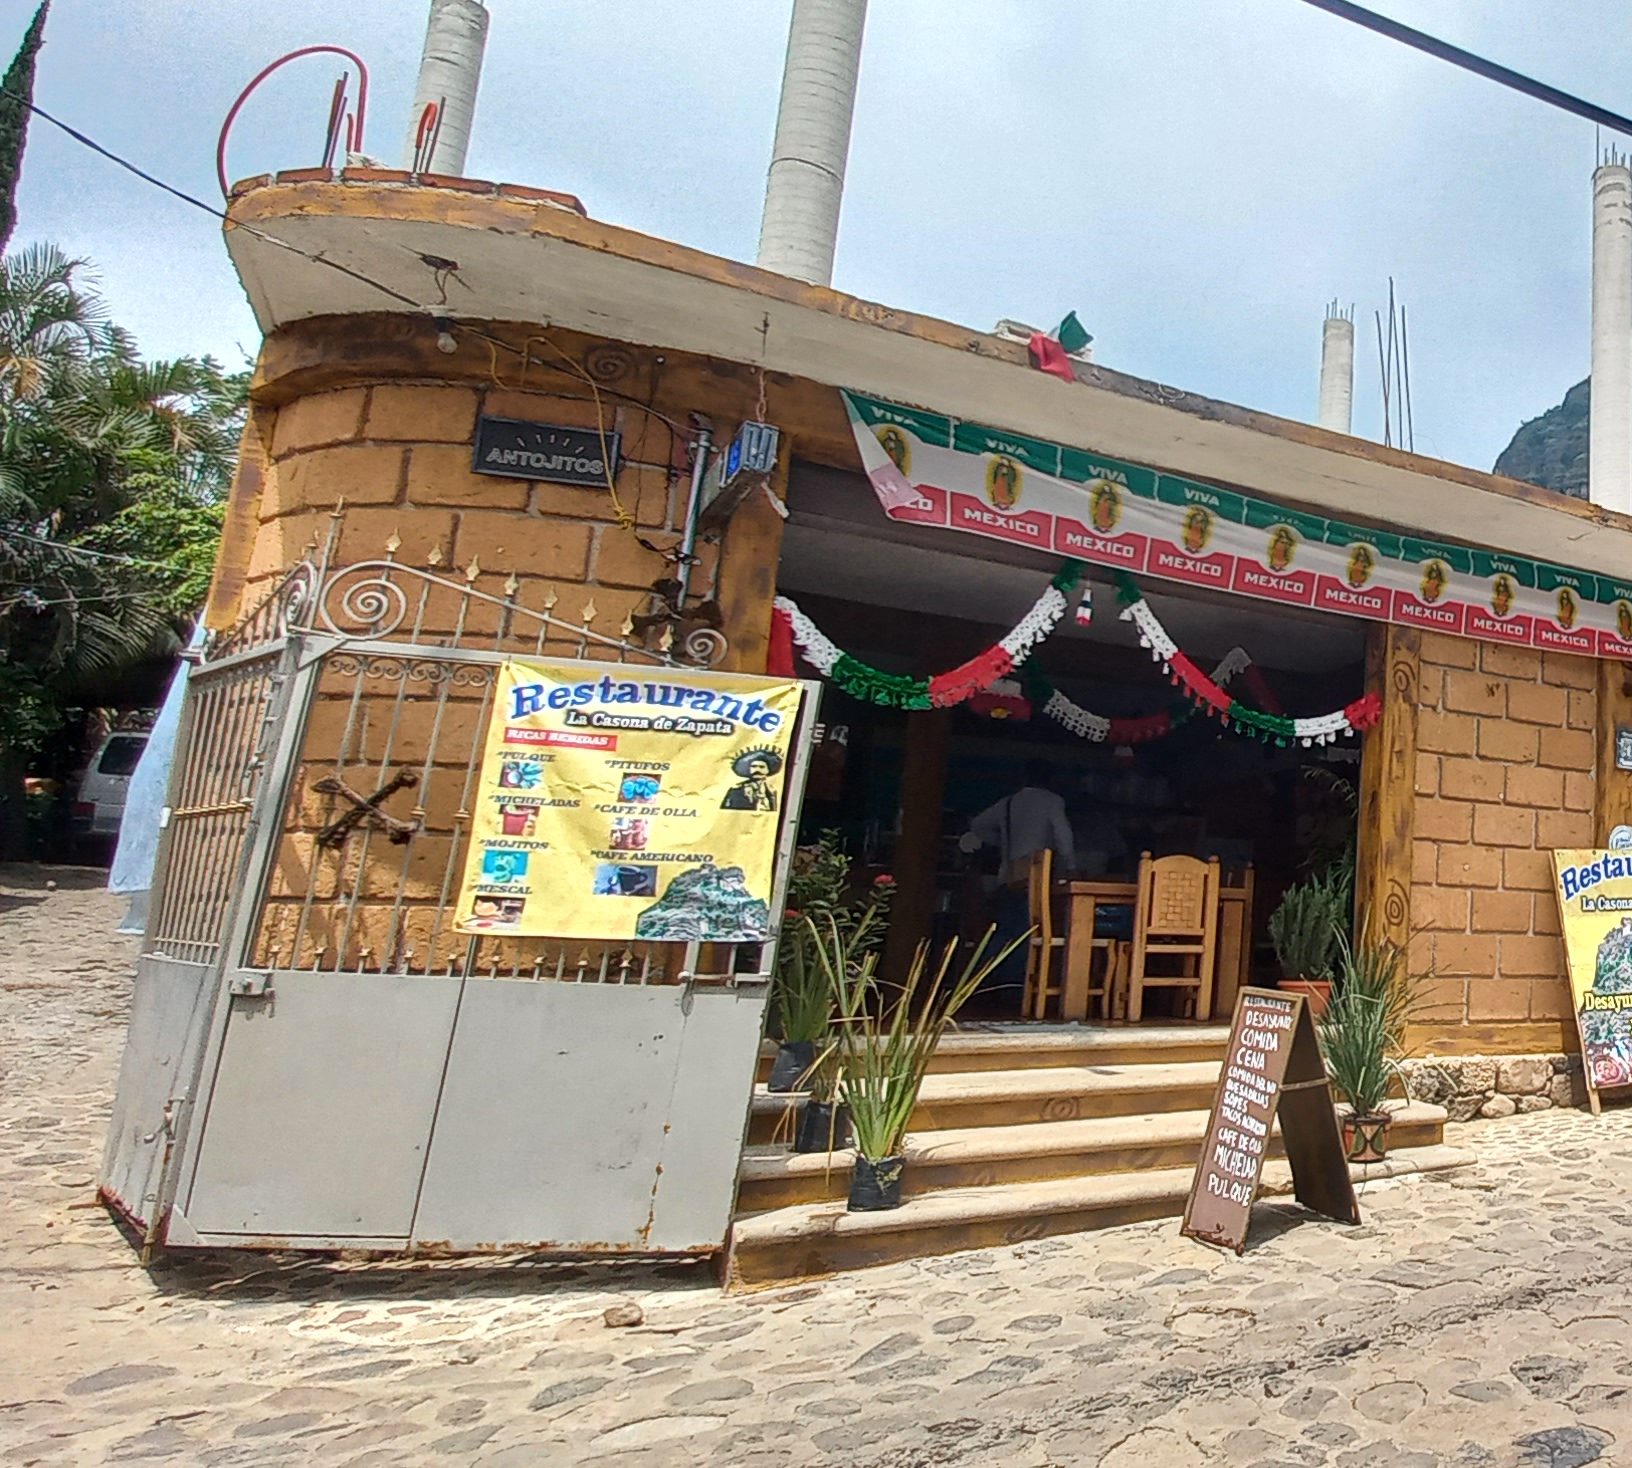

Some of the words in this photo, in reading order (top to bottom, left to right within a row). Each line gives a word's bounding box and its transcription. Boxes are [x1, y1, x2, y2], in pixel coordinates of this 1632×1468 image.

[871, 406, 919, 426] VIVA
[986, 437, 1029, 456] VIVA
[485, 447, 603, 475] ANTOJITOS
[1088, 465, 1128, 484] VIVA
[1184, 487, 1219, 506] VIVA
[964, 507, 1039, 536] MEXICO
[1066, 532, 1135, 559] MEXICO
[1158, 553, 1222, 577] MEXICO
[1490, 560, 1518, 574] VIVA
[1244, 572, 1304, 594] MEXICO
[1554, 574, 1580, 588] VIVA
[1325, 588, 1381, 609] MEXICO
[1402, 603, 1455, 623] MEXICO
[1473, 617, 1524, 636] MEXICO
[1541, 630, 1588, 647] MEXICO
[510, 675, 782, 733] Restaurante
[567, 711, 588, 726] La
[592, 713, 649, 730] Casona
[653, 717, 673, 731] de
[675, 718, 732, 736] Zapata
[507, 729, 546, 741] RICAS
[548, 732, 609, 746] BEBIDAS
[500, 751, 557, 763] PULQUE
[608, 760, 671, 771] PITUFOS
[492, 795, 581, 808] MICHELADAS
[598, 804, 637, 815] CAFE
[640, 806, 661, 816] DE
[662, 808, 698, 818] OLLA
[484, 840, 549, 849] MOJITOS
[595, 850, 628, 861] CAFE
[630, 851, 714, 863] AMERICANO
[476, 884, 533, 895] MESCAL
[1582, 897, 1596, 911] La
[1241, 1028, 1279, 1051] COMIDA
[1236, 1047, 1265, 1070] CENA
[1227, 1065, 1255, 1086] COMIDA
[1223, 1090, 1248, 1113] SOPES
[1222, 1105, 1242, 1126] TACOS
[1218, 1127, 1238, 1147] CAFE
[1238, 1134, 1249, 1151] DE
[1207, 1173, 1252, 1207] PULQUE
